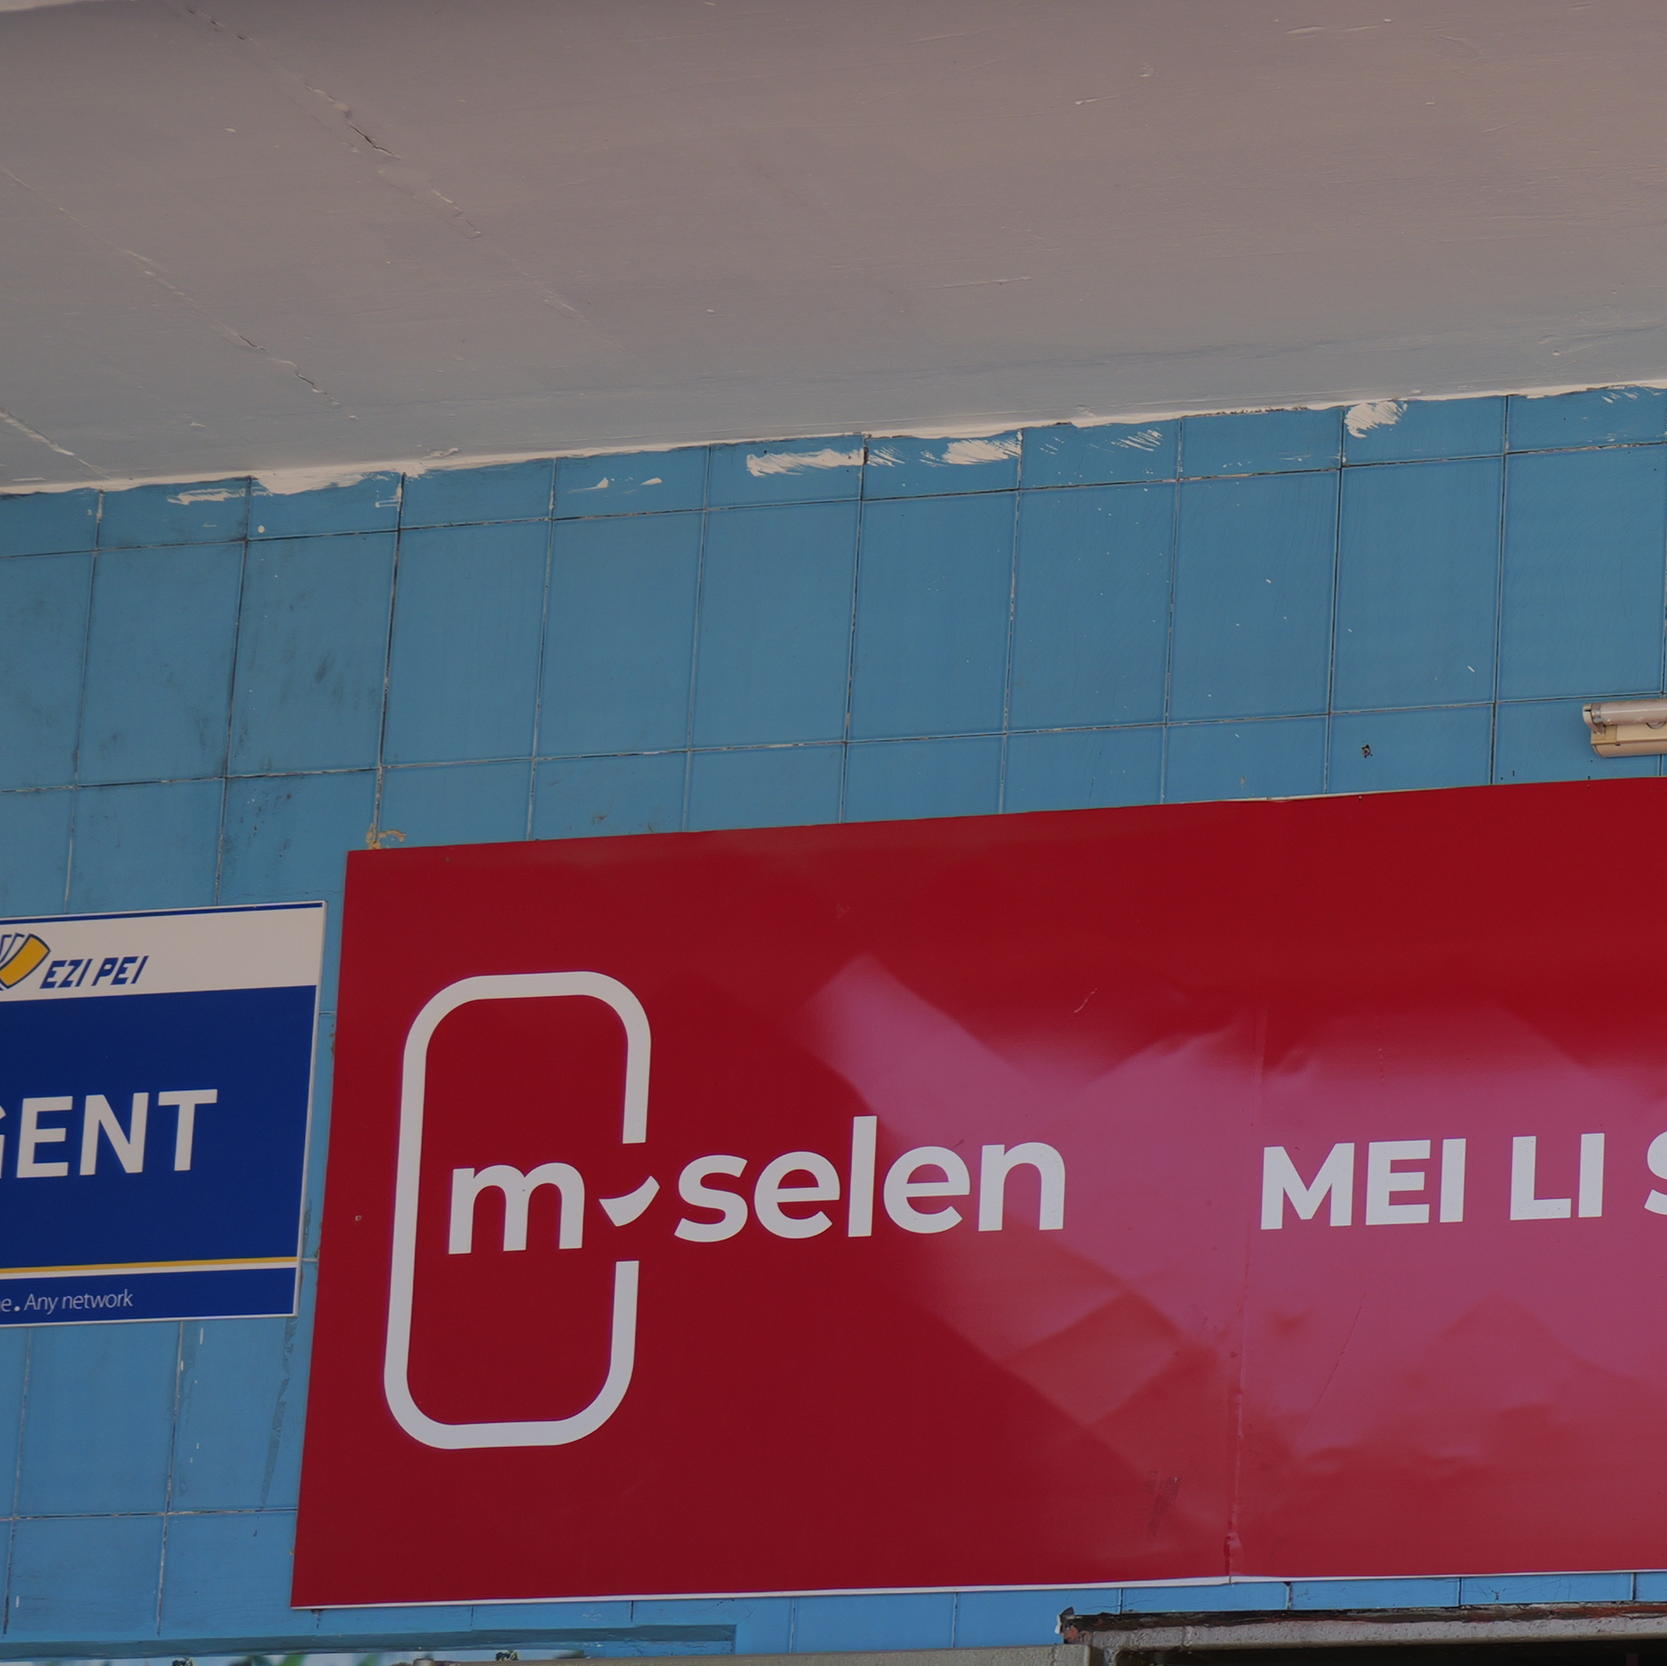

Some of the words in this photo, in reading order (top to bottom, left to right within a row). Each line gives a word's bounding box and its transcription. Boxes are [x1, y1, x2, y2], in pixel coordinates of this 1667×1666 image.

[40, 958, 92, 989] EZI
[92, 956, 149, 986] PEI
[0, 1089, 218, 1178] ENT
[1260, 1139, 1466, 1230] MEI
[1509, 1133, 1605, 1220] LI
[25, 1293, 57, 1315] Any
[63, 1289, 133, 1309] network
